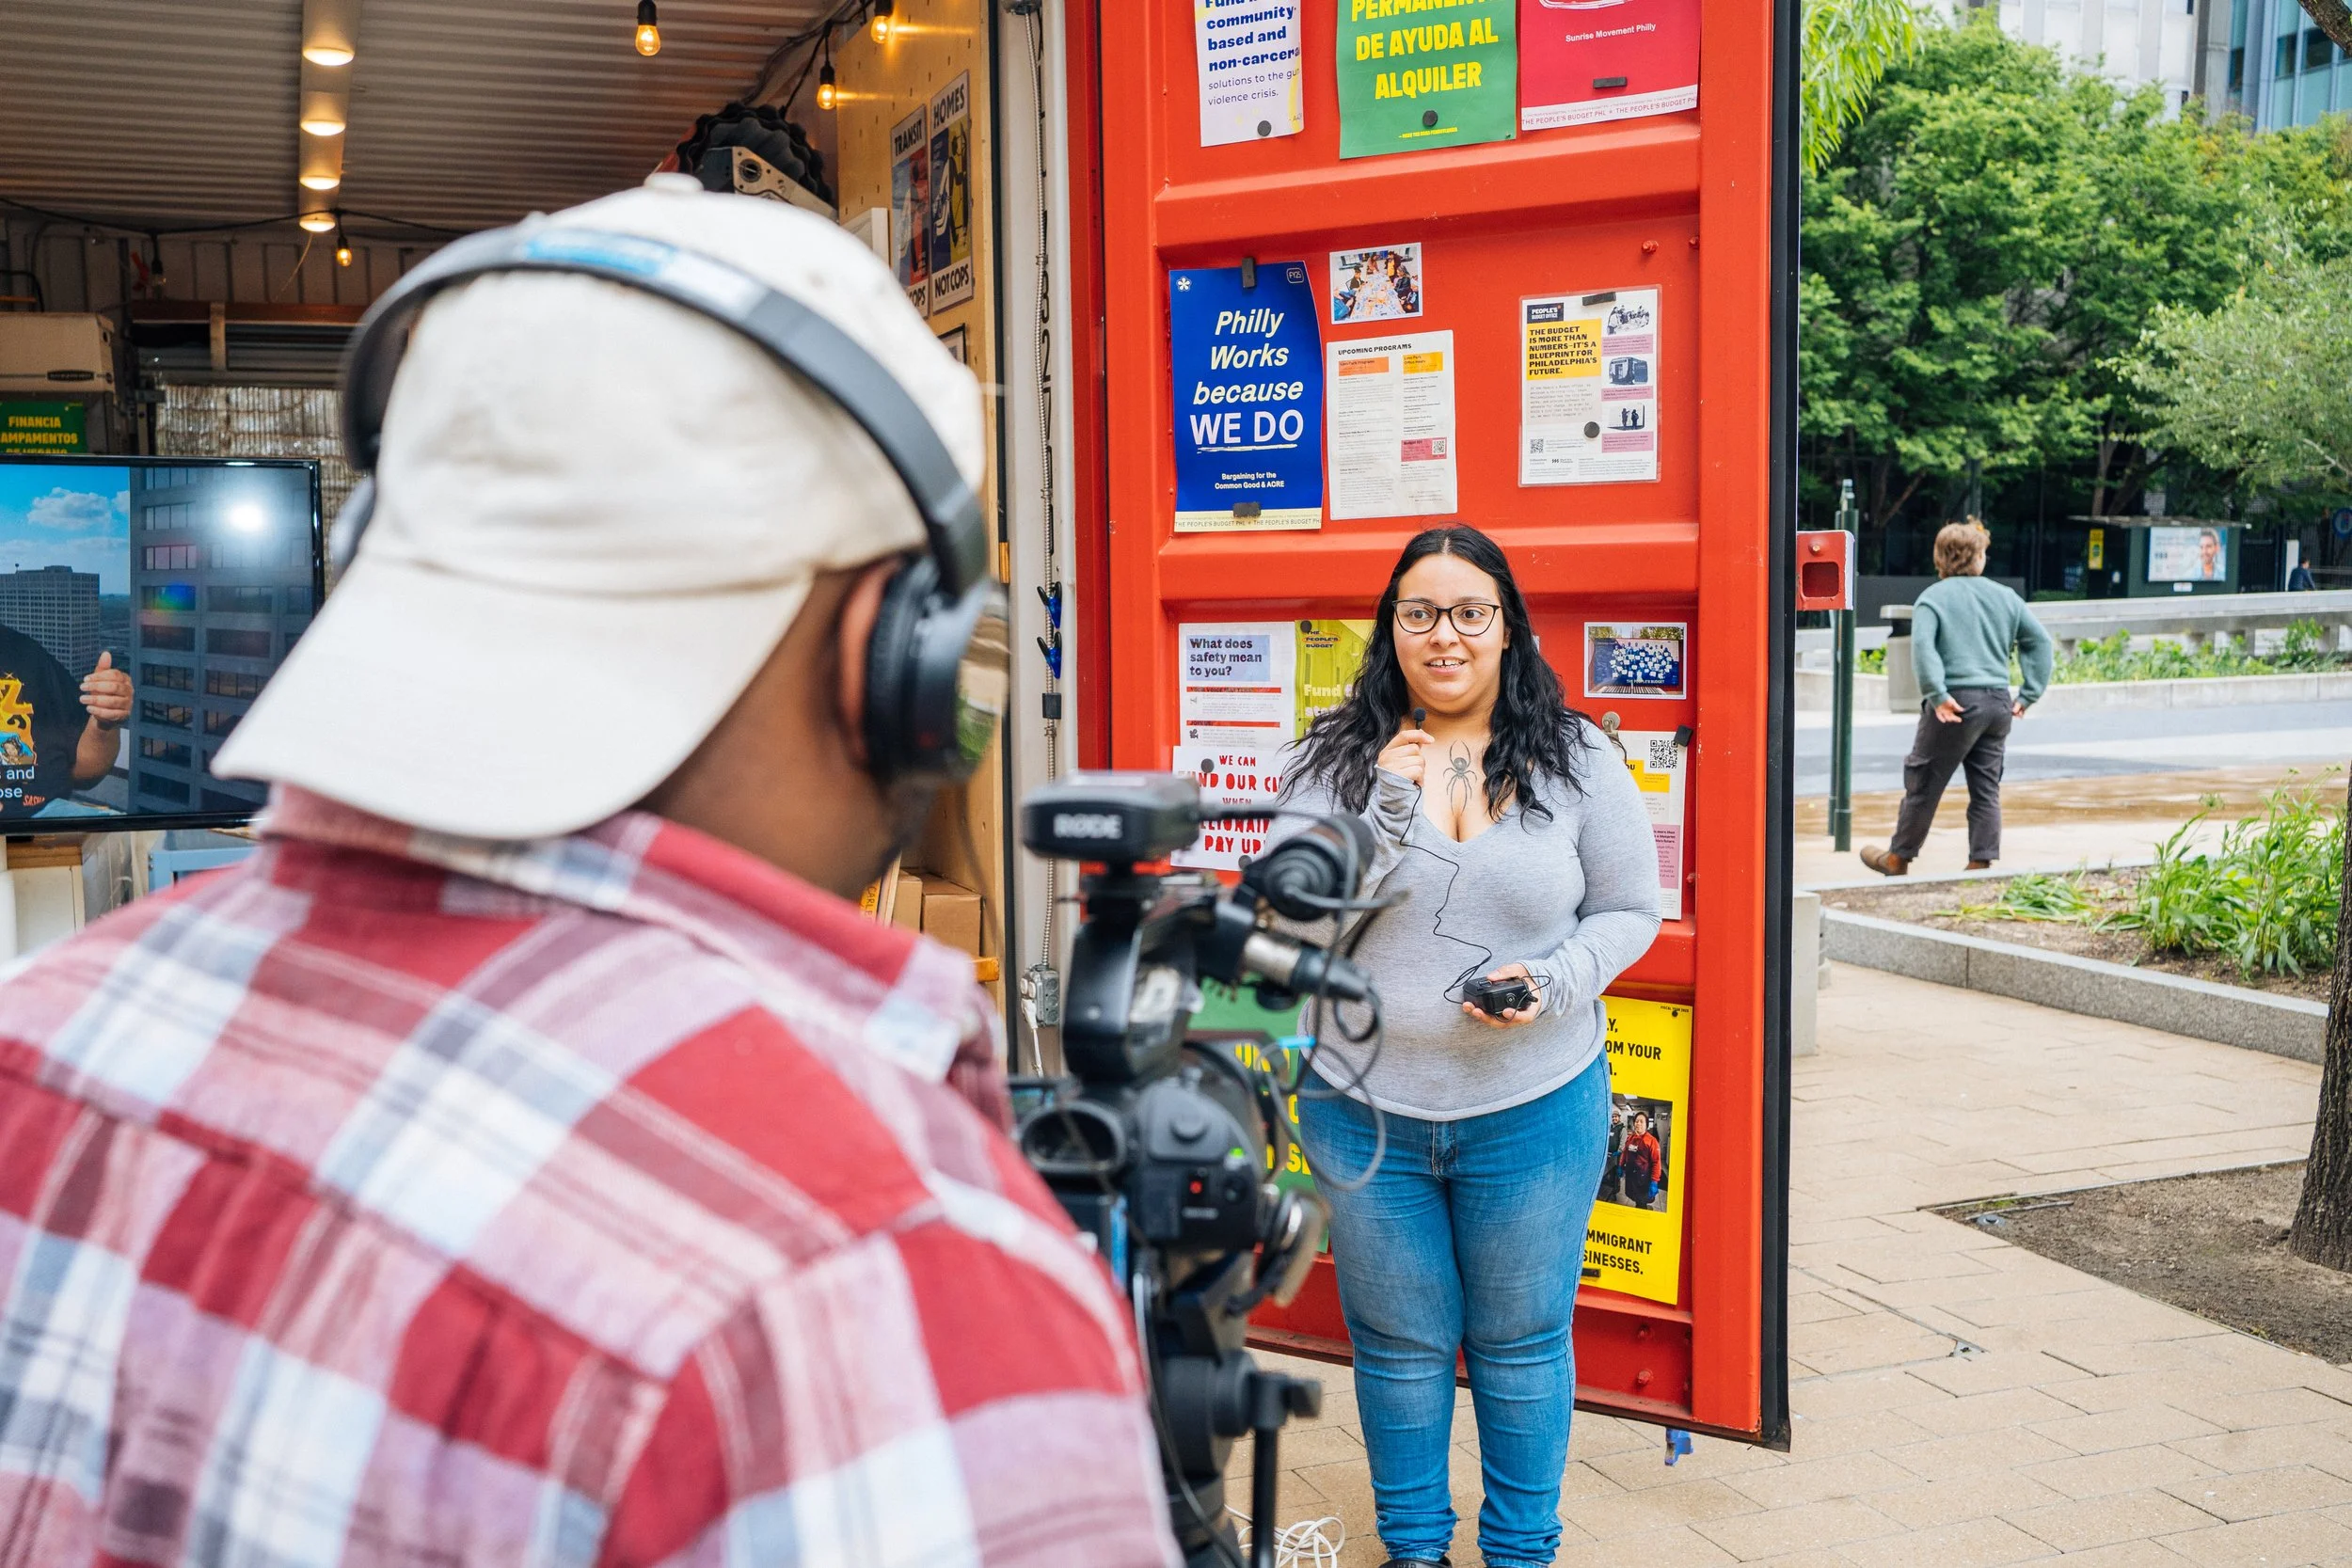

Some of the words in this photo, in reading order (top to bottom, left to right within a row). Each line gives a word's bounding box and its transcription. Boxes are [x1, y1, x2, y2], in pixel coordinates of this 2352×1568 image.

[1208, 31, 1254, 51] based
[1258, 25, 1287, 42] and
[1356, 32, 1384, 61] DE
[1389, 22, 1465, 57] AYUDA
[1469, 17, 1499, 46] AL
[1565, 33, 1595, 42] Sunrise
[1596, 25, 1635, 39] Movement
[1636, 23, 1657, 34] Philly
[1208, 76, 1252, 90] solutions
[1255, 74, 1265, 83] to
[1268, 71, 1284, 81] the
[1375, 61, 1483, 100] ALQUILER
[1208, 91, 1248, 105] violence
[1251, 88, 1279, 100] crisis.
[933, 83, 965, 129] HOMES
[1567, 111, 1593, 121] BUDGET
[1661, 98, 1686, 108] BUDGET
[894, 118, 922, 157] TRANSIT
[934, 272, 950, 298] NOT
[950, 263, 970, 292] COPS
[1215, 308, 1285, 339] Philly
[1548, 325, 1581, 335] BUDGET
[1564, 333, 1587, 341] THAN
[1210, 342, 1290, 371] Works
[1338, 346, 1373, 356] UPCOMING
[1374, 342, 1412, 353] PROGRAMS
[1530, 350, 1575, 359] BLUEPRINT
[1530, 356, 1597, 368] PHILADELPHIA'S
[1193, 380, 1304, 405] because
[8, 416, 62, 429] FINANCIA
[1189, 412, 1242, 446] WE
[1253, 409, 1304, 443] DO
[1215, 482, 1242, 490] Common
[1243, 481, 1261, 489] Good
[1221, 472, 1255, 481] Bargaining
[1189, 638, 1222, 649] What
[1225, 638, 1253, 649] does
[1190, 651, 1227, 665] safety
[1229, 653, 1263, 663] mean
[1189, 666, 1202, 676] to
[1204, 665, 1232, 678] you?
[1303, 683, 1341, 697] Fund
[1218, 754, 1233, 766] WE
[1237, 756, 1256, 768] CAN
[6, 765, 35, 780] and
[1225, 772, 1257, 791] OUR
[1204, 835, 1234, 853] PAY
[1628, 1042, 1662, 1061] YOUR
